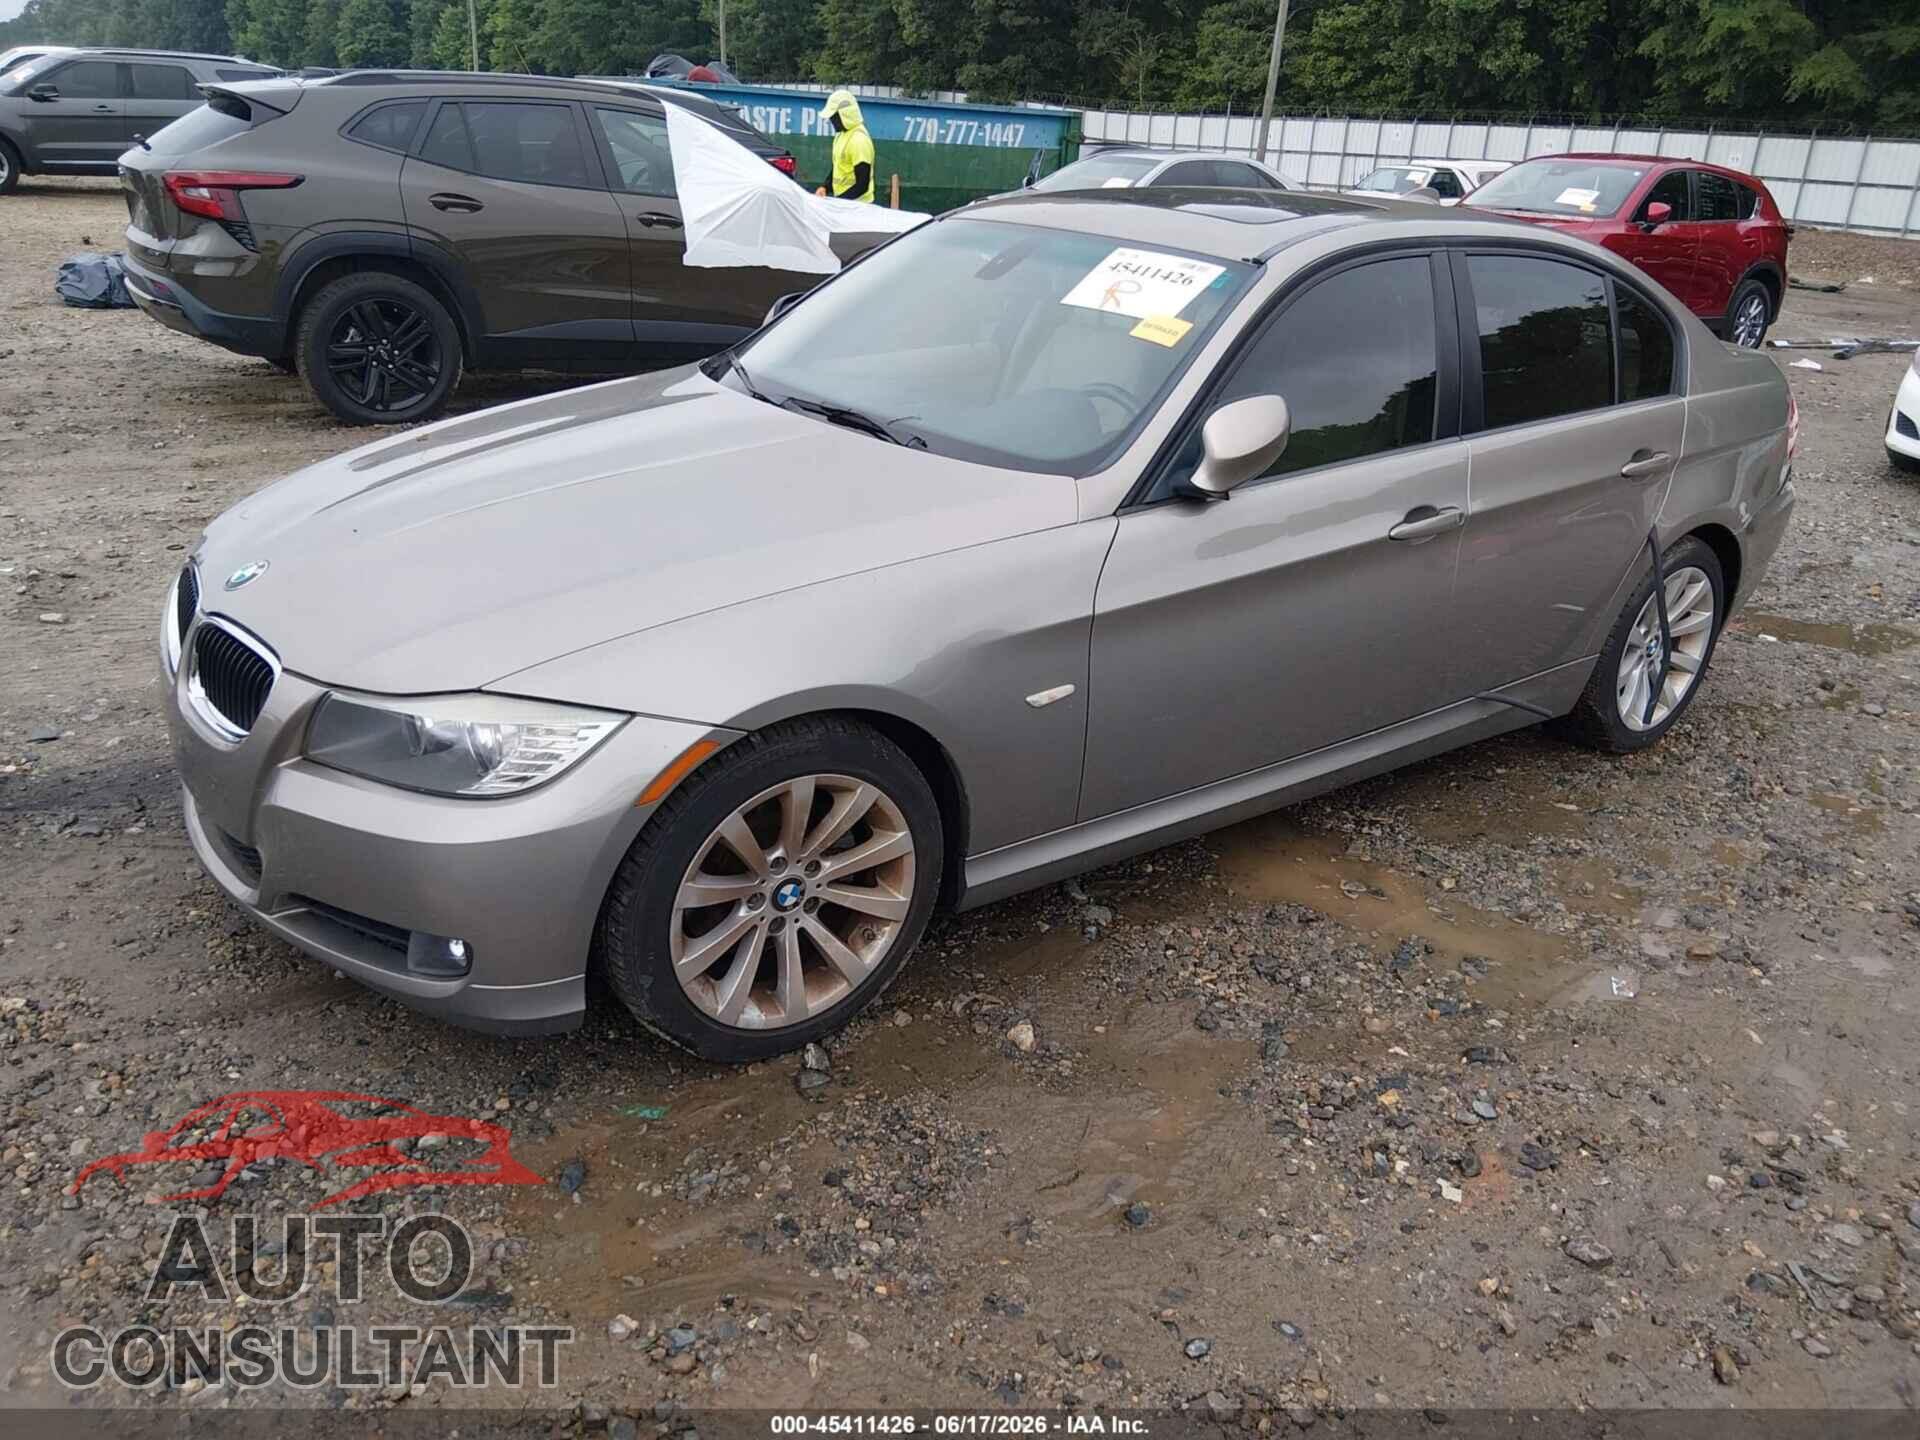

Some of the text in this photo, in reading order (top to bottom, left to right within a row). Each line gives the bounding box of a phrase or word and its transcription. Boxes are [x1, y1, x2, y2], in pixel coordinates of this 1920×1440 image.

[733, 102, 792, 135] ASTE
[903, 116, 1025, 148] 770-777-1447
[1108, 261, 1194, 287] 45411426
